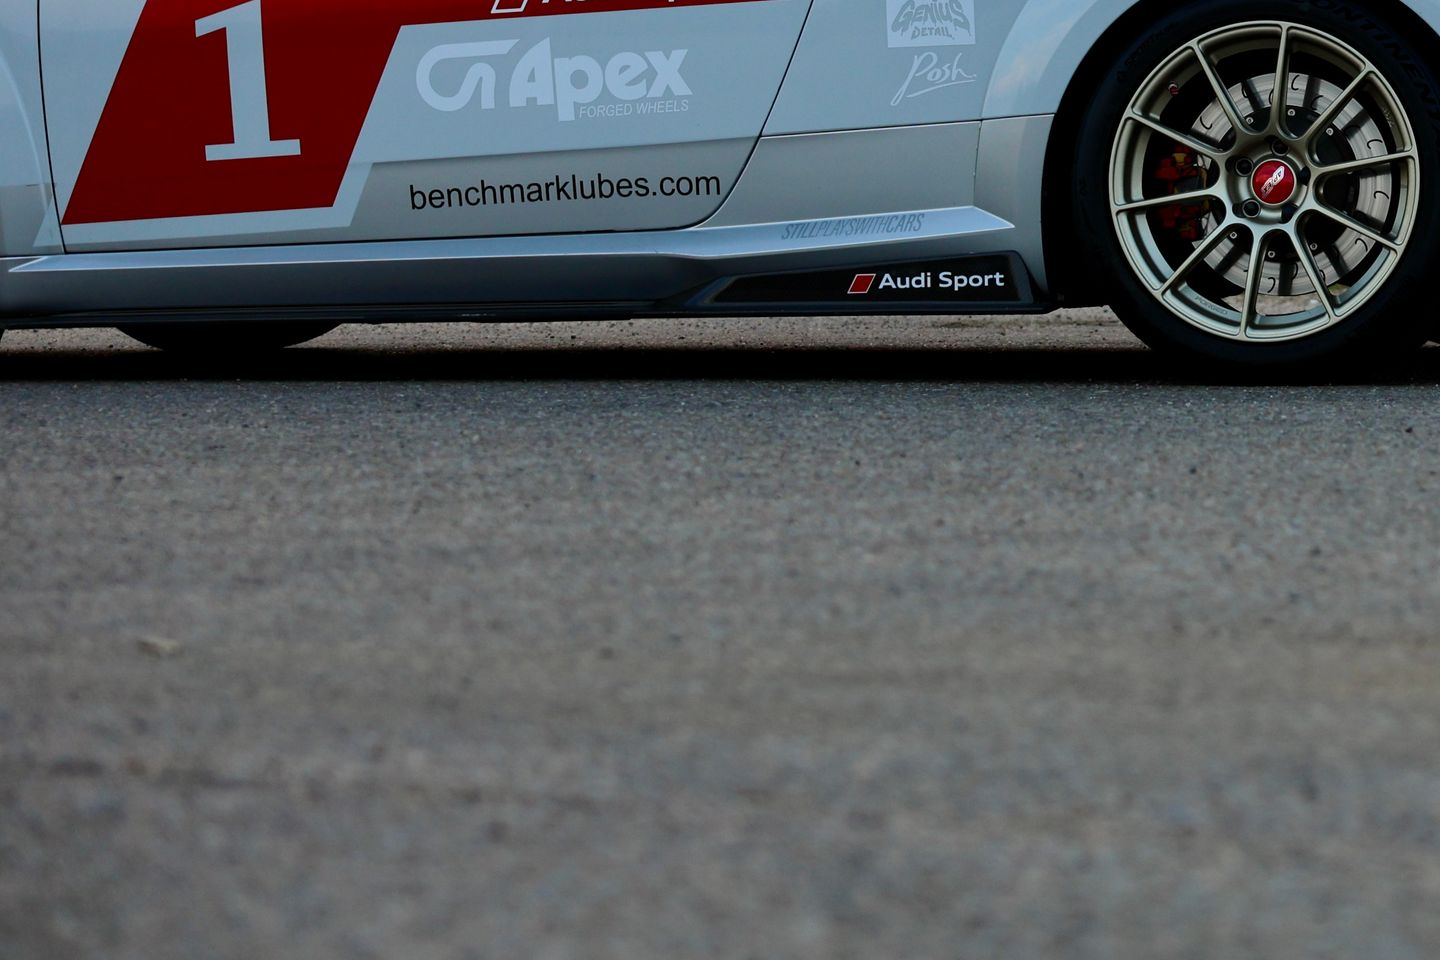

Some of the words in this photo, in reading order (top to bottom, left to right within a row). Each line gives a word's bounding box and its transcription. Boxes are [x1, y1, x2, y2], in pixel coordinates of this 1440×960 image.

[911, 25, 953, 40] DETAIL
[578, 101, 633, 119] FORGED
[635, 98, 689, 115] WHEELS
[408, 172, 722, 210] benchmarklubes.com
[878, 272, 931, 289] Audi
[938, 271, 1005, 291] Sport
